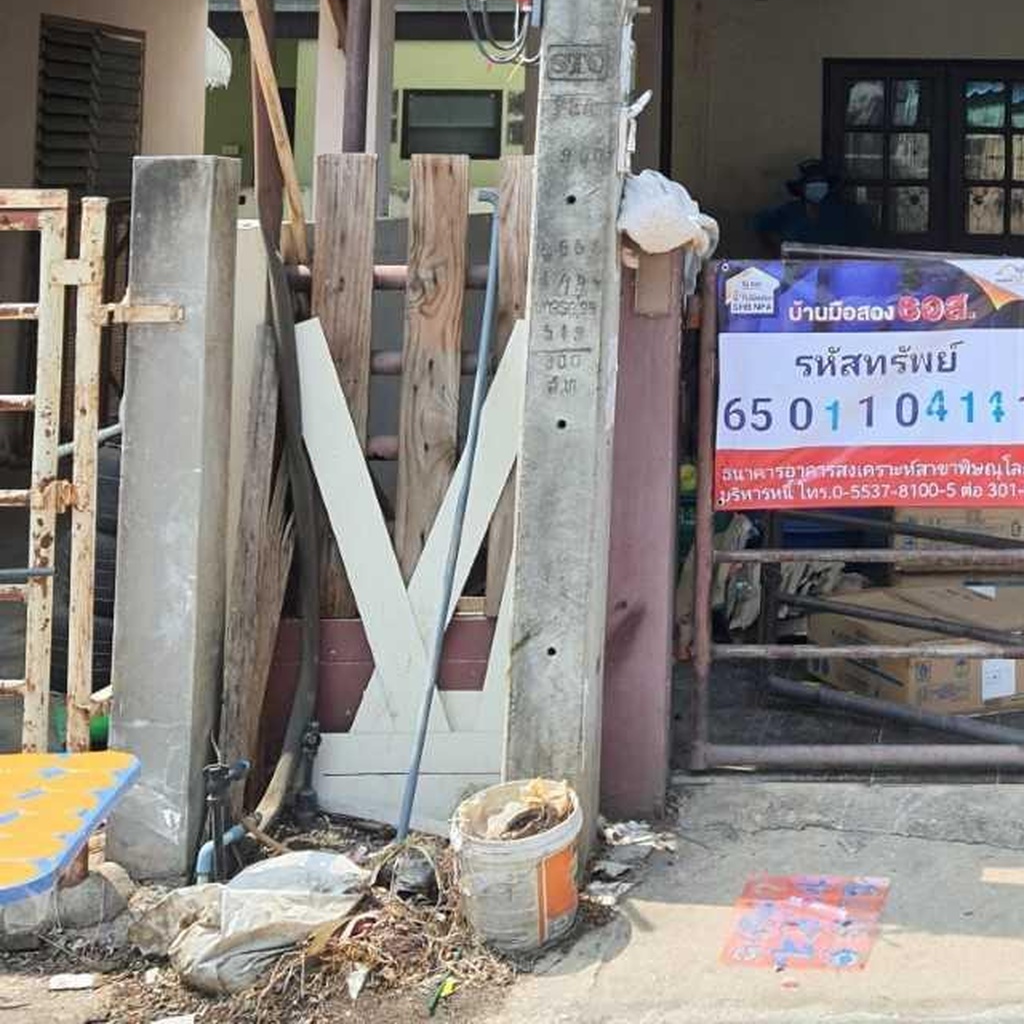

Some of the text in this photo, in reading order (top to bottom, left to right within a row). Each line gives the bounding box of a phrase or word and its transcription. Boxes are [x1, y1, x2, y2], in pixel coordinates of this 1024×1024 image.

[788, 300, 895, 322] บ้านมือสอง
[795, 340, 964, 377] รหัสทรัพย์
[960, 481, 983, 498] ต่อ
